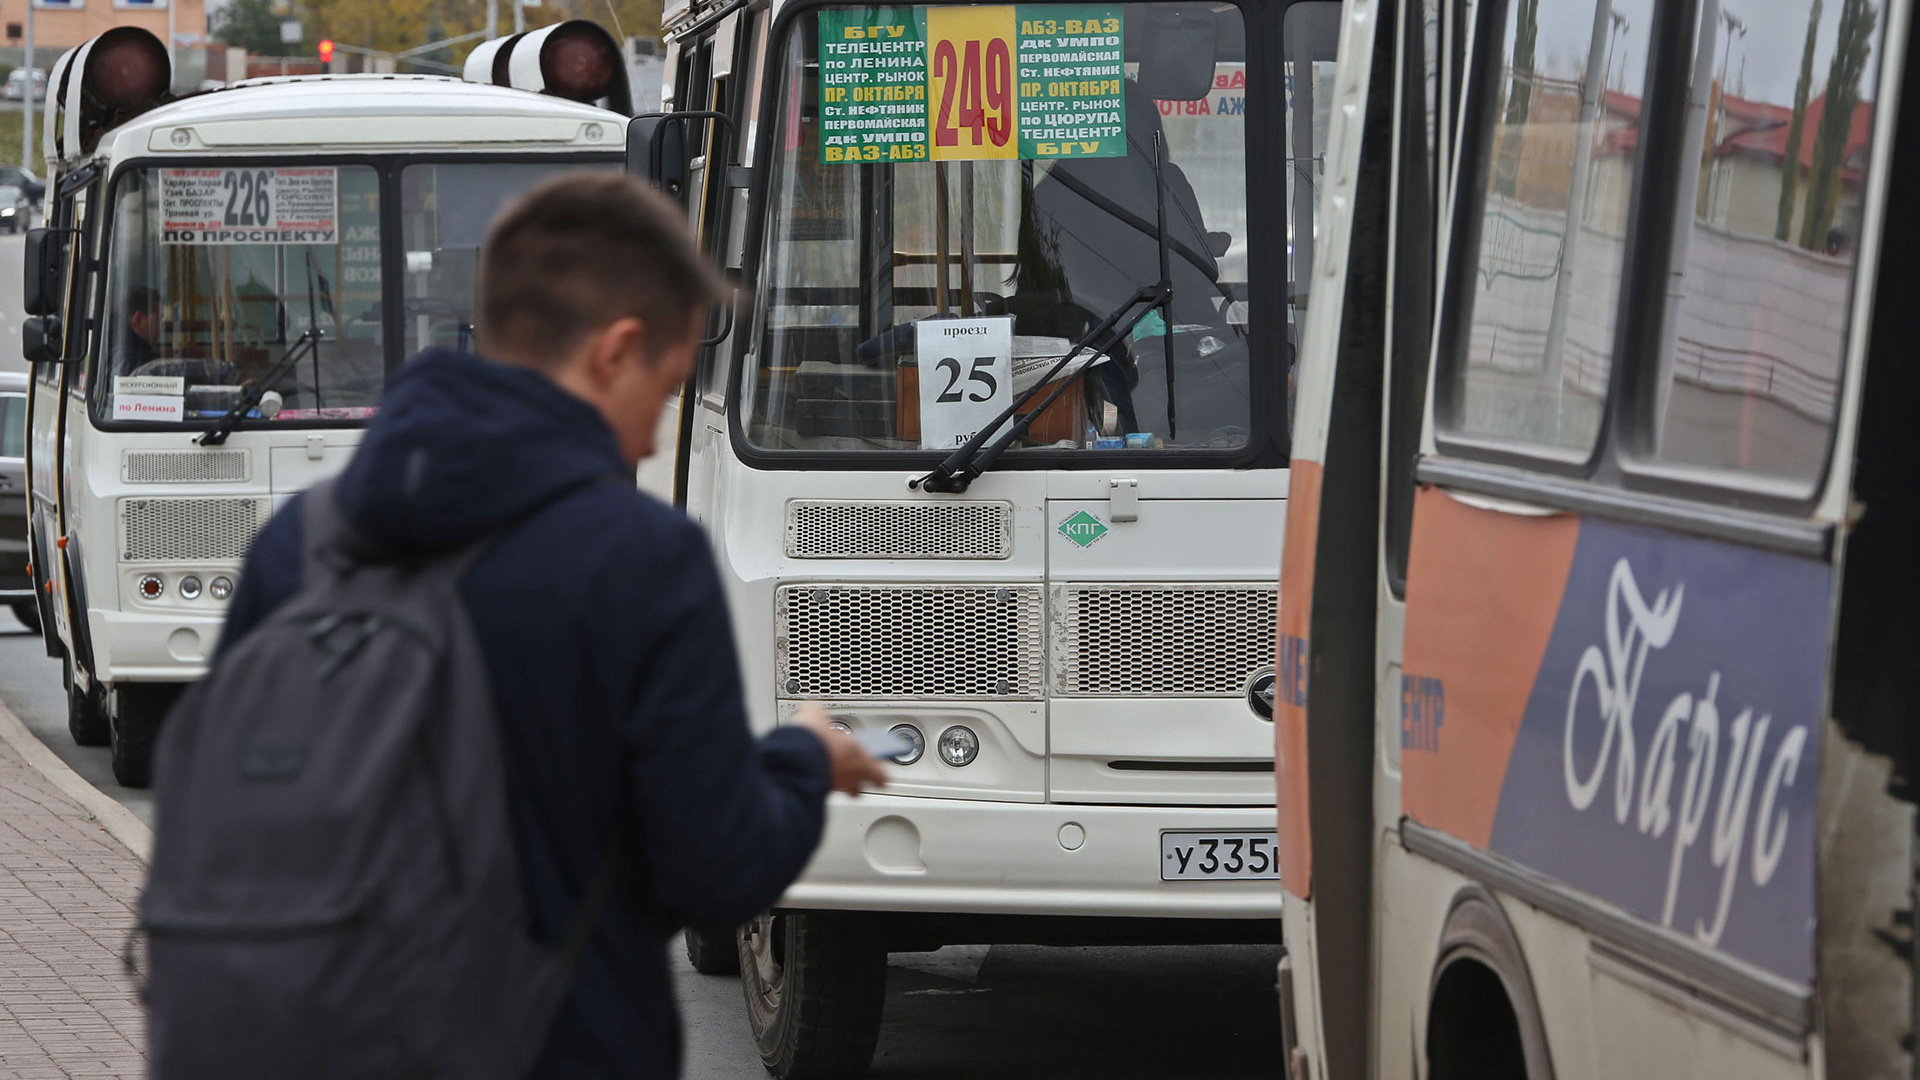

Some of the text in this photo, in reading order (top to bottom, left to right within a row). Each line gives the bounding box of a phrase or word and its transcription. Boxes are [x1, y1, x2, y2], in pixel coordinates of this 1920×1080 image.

[844, 25, 905, 39] БГУ
[1021, 18, 1120, 35] АБЗ-ВАЗ
[825, 41, 925, 54] ТЕЛЕЦЕНТР
[1056, 36, 1120, 47] УМПО
[825, 56, 924, 69] по ЛЕНИНА
[1020, 50, 1120, 63] ПЕРВОМАЙСКАЯ
[825, 71, 925, 85] ЦЕНТР. РЫНОК
[1020, 65, 1120, 77] Ст. НЕФТЯНИК
[825, 85, 925, 102] ПР. ОКТЯБРЯ
[934, 37, 1012, 147] 249
[1021, 79, 1120, 97] ПР. ОКТЯБРЯ
[825, 104, 925, 116] Ст. НЕФТЯНИК
[1021, 99, 1120, 113] ЦЕНТР. РЫНОК
[825, 117, 925, 130] ПЕРВОМАЙСКАЯ
[1021, 112, 1121, 127] по ЦЮРУПА
[862, 132, 925, 143] УМПО
[1021, 126, 1121, 140] ТЕЛЕЦЕНТР
[825, 144, 926, 161] ВАЗ-АБЗ
[1037, 141, 1099, 155] БГУ
[185, 188, 215, 197] БАЗАР
[224, 170, 269, 226] 226
[179, 199, 224, 208] ПРОСПЕКТЫ
[164, 230, 334, 242] ПО ПРОСПЕКТУ
[943, 326, 988, 338] проезд
[935, 356, 998, 403] 25
[119, 403, 176, 413] по Ленина
[1066, 523, 1100, 535] КПГ
[1563, 557, 1808, 947] Парус
[1174, 838, 1279, 874] У335
